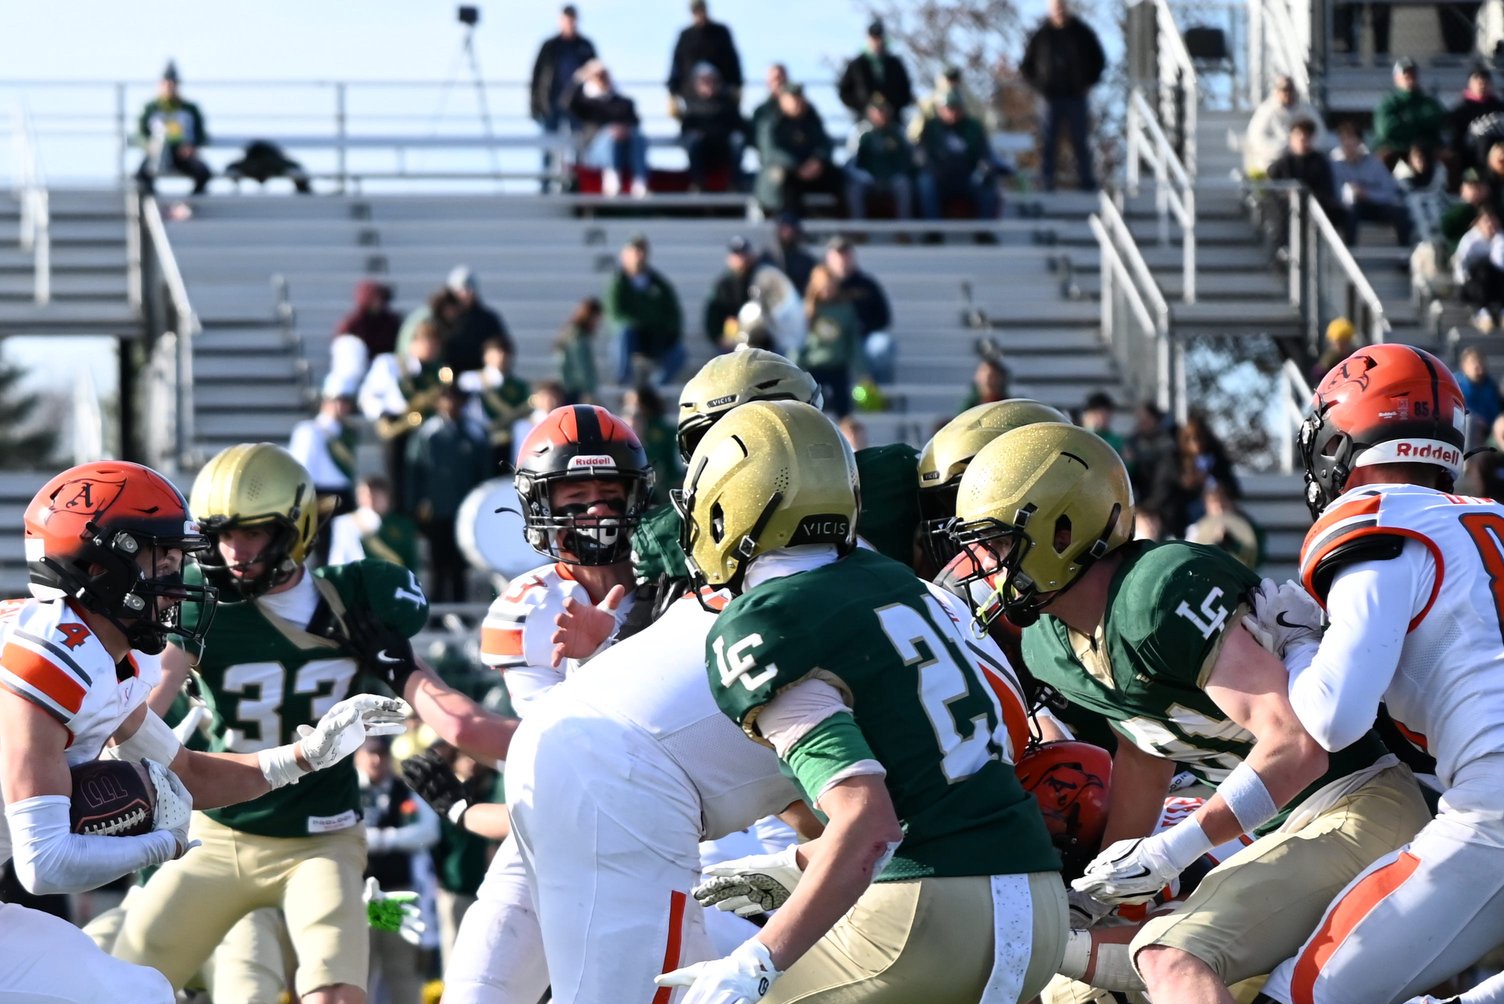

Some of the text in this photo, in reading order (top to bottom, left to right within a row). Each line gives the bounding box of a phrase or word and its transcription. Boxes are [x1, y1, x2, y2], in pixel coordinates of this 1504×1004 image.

[712, 396, 732, 406] VICIS
[1413, 400, 1430, 418] 85
[575, 457, 611, 466] Riddell
[1397, 442, 1460, 467] Riddell
[65, 482, 94, 509] A
[803, 521, 847, 537] VICIS
[56, 622, 93, 651] 4
